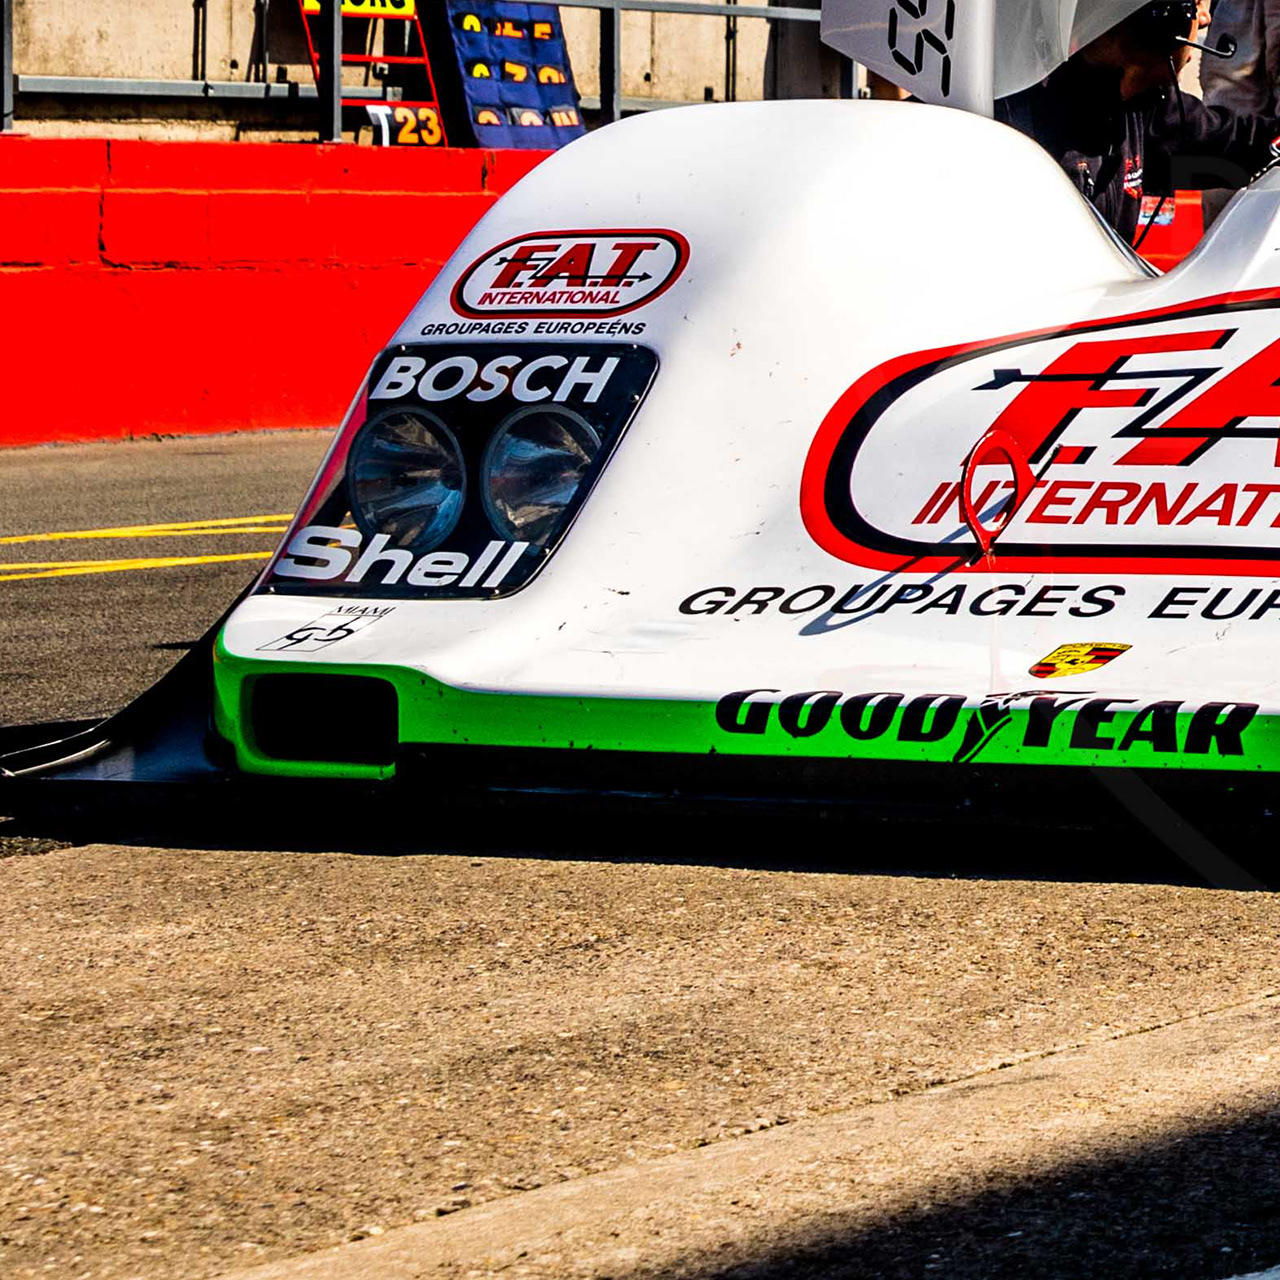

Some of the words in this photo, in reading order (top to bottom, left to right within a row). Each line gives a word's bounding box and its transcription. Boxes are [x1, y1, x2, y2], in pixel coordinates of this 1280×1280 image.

[489, 240, 662, 289] F.A.T.
[477, 289, 622, 308] INTERNATIONAL
[420, 319, 529, 339] GROUPAGES
[532, 318, 647, 340] EUROPEÉNS
[369, 353, 621, 405] BOSCH
[273, 524, 530, 590] Shell
[330, 605, 397, 616] MIAMI
[678, 582, 1128, 619] GROUPAGES
